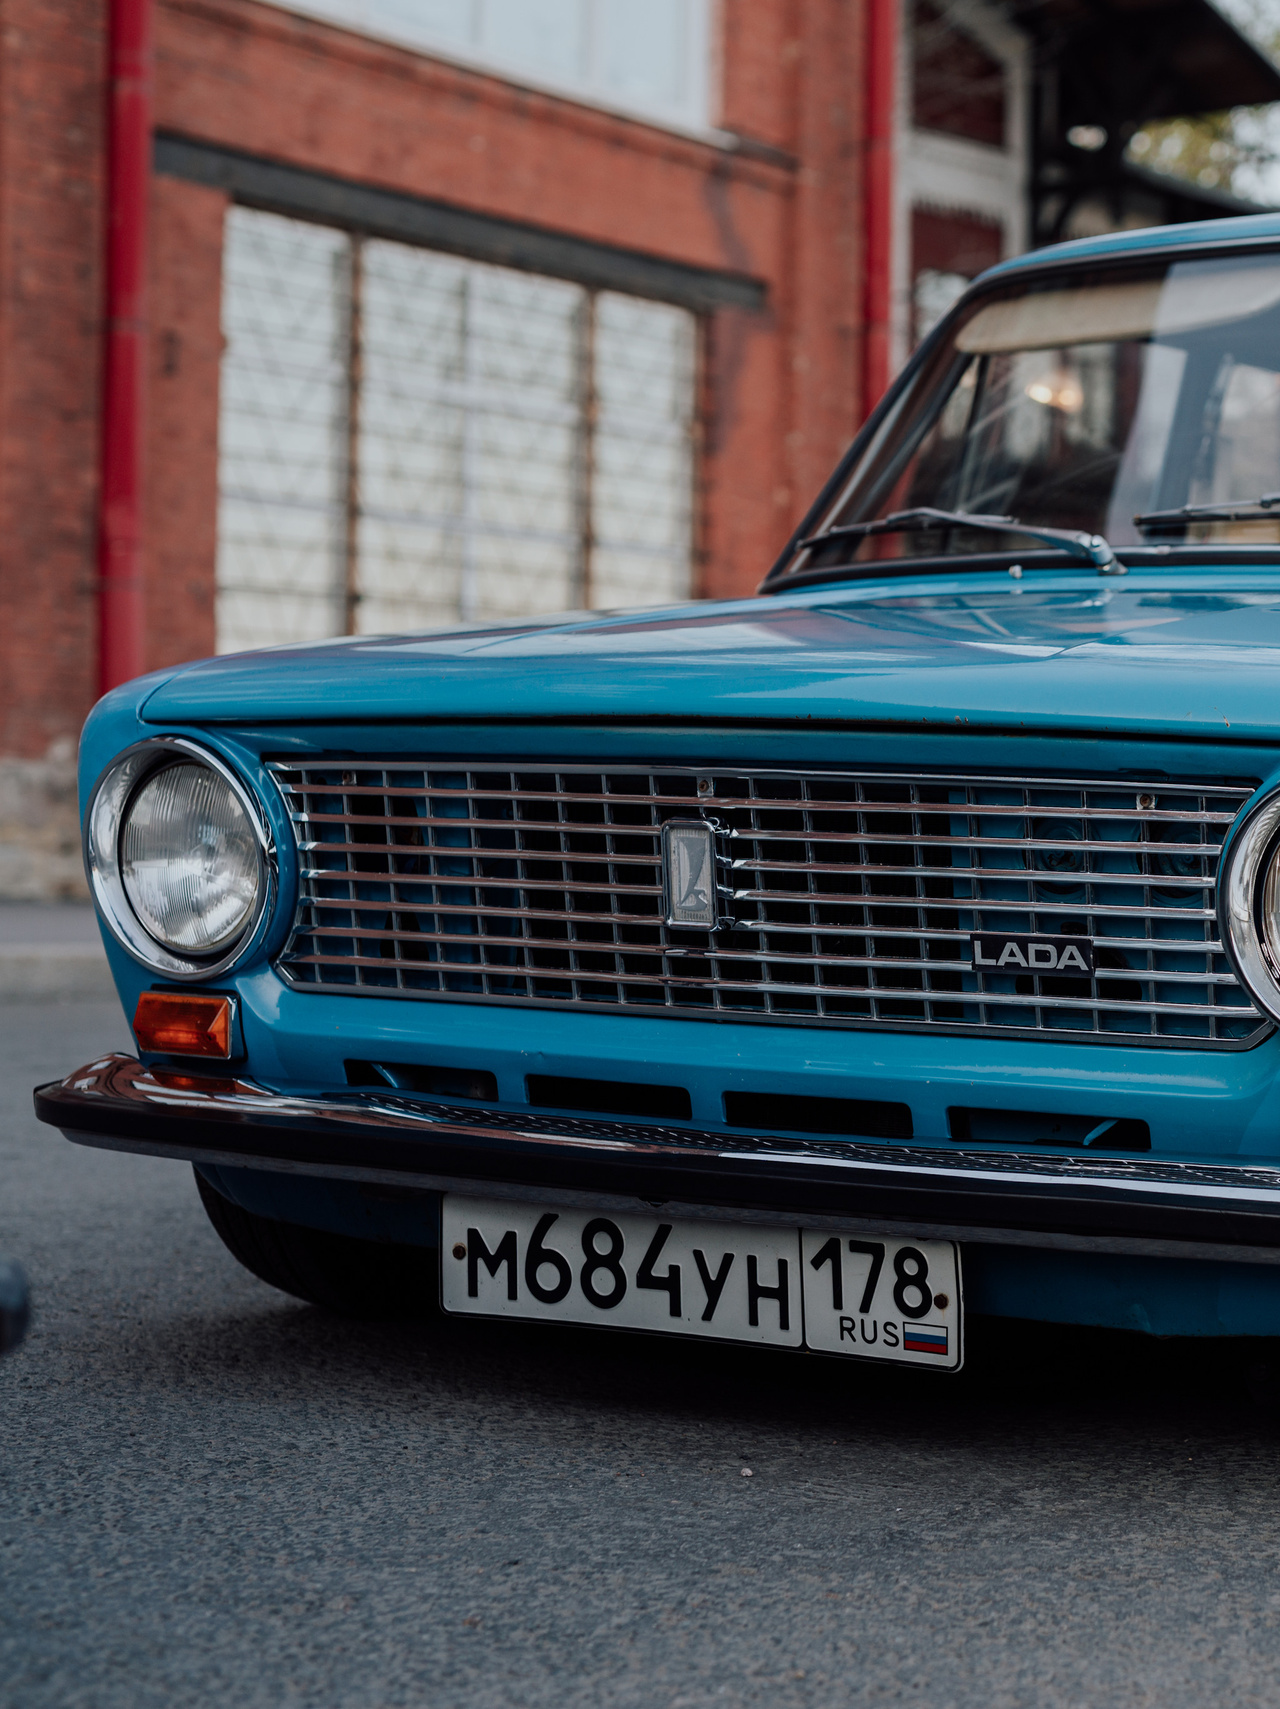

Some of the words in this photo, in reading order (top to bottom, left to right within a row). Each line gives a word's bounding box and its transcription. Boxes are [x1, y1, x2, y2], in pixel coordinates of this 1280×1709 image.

[973, 940, 1090, 971] LADA
[809, 1237, 934, 1319] 178
[839, 1316, 900, 1347] RUS
